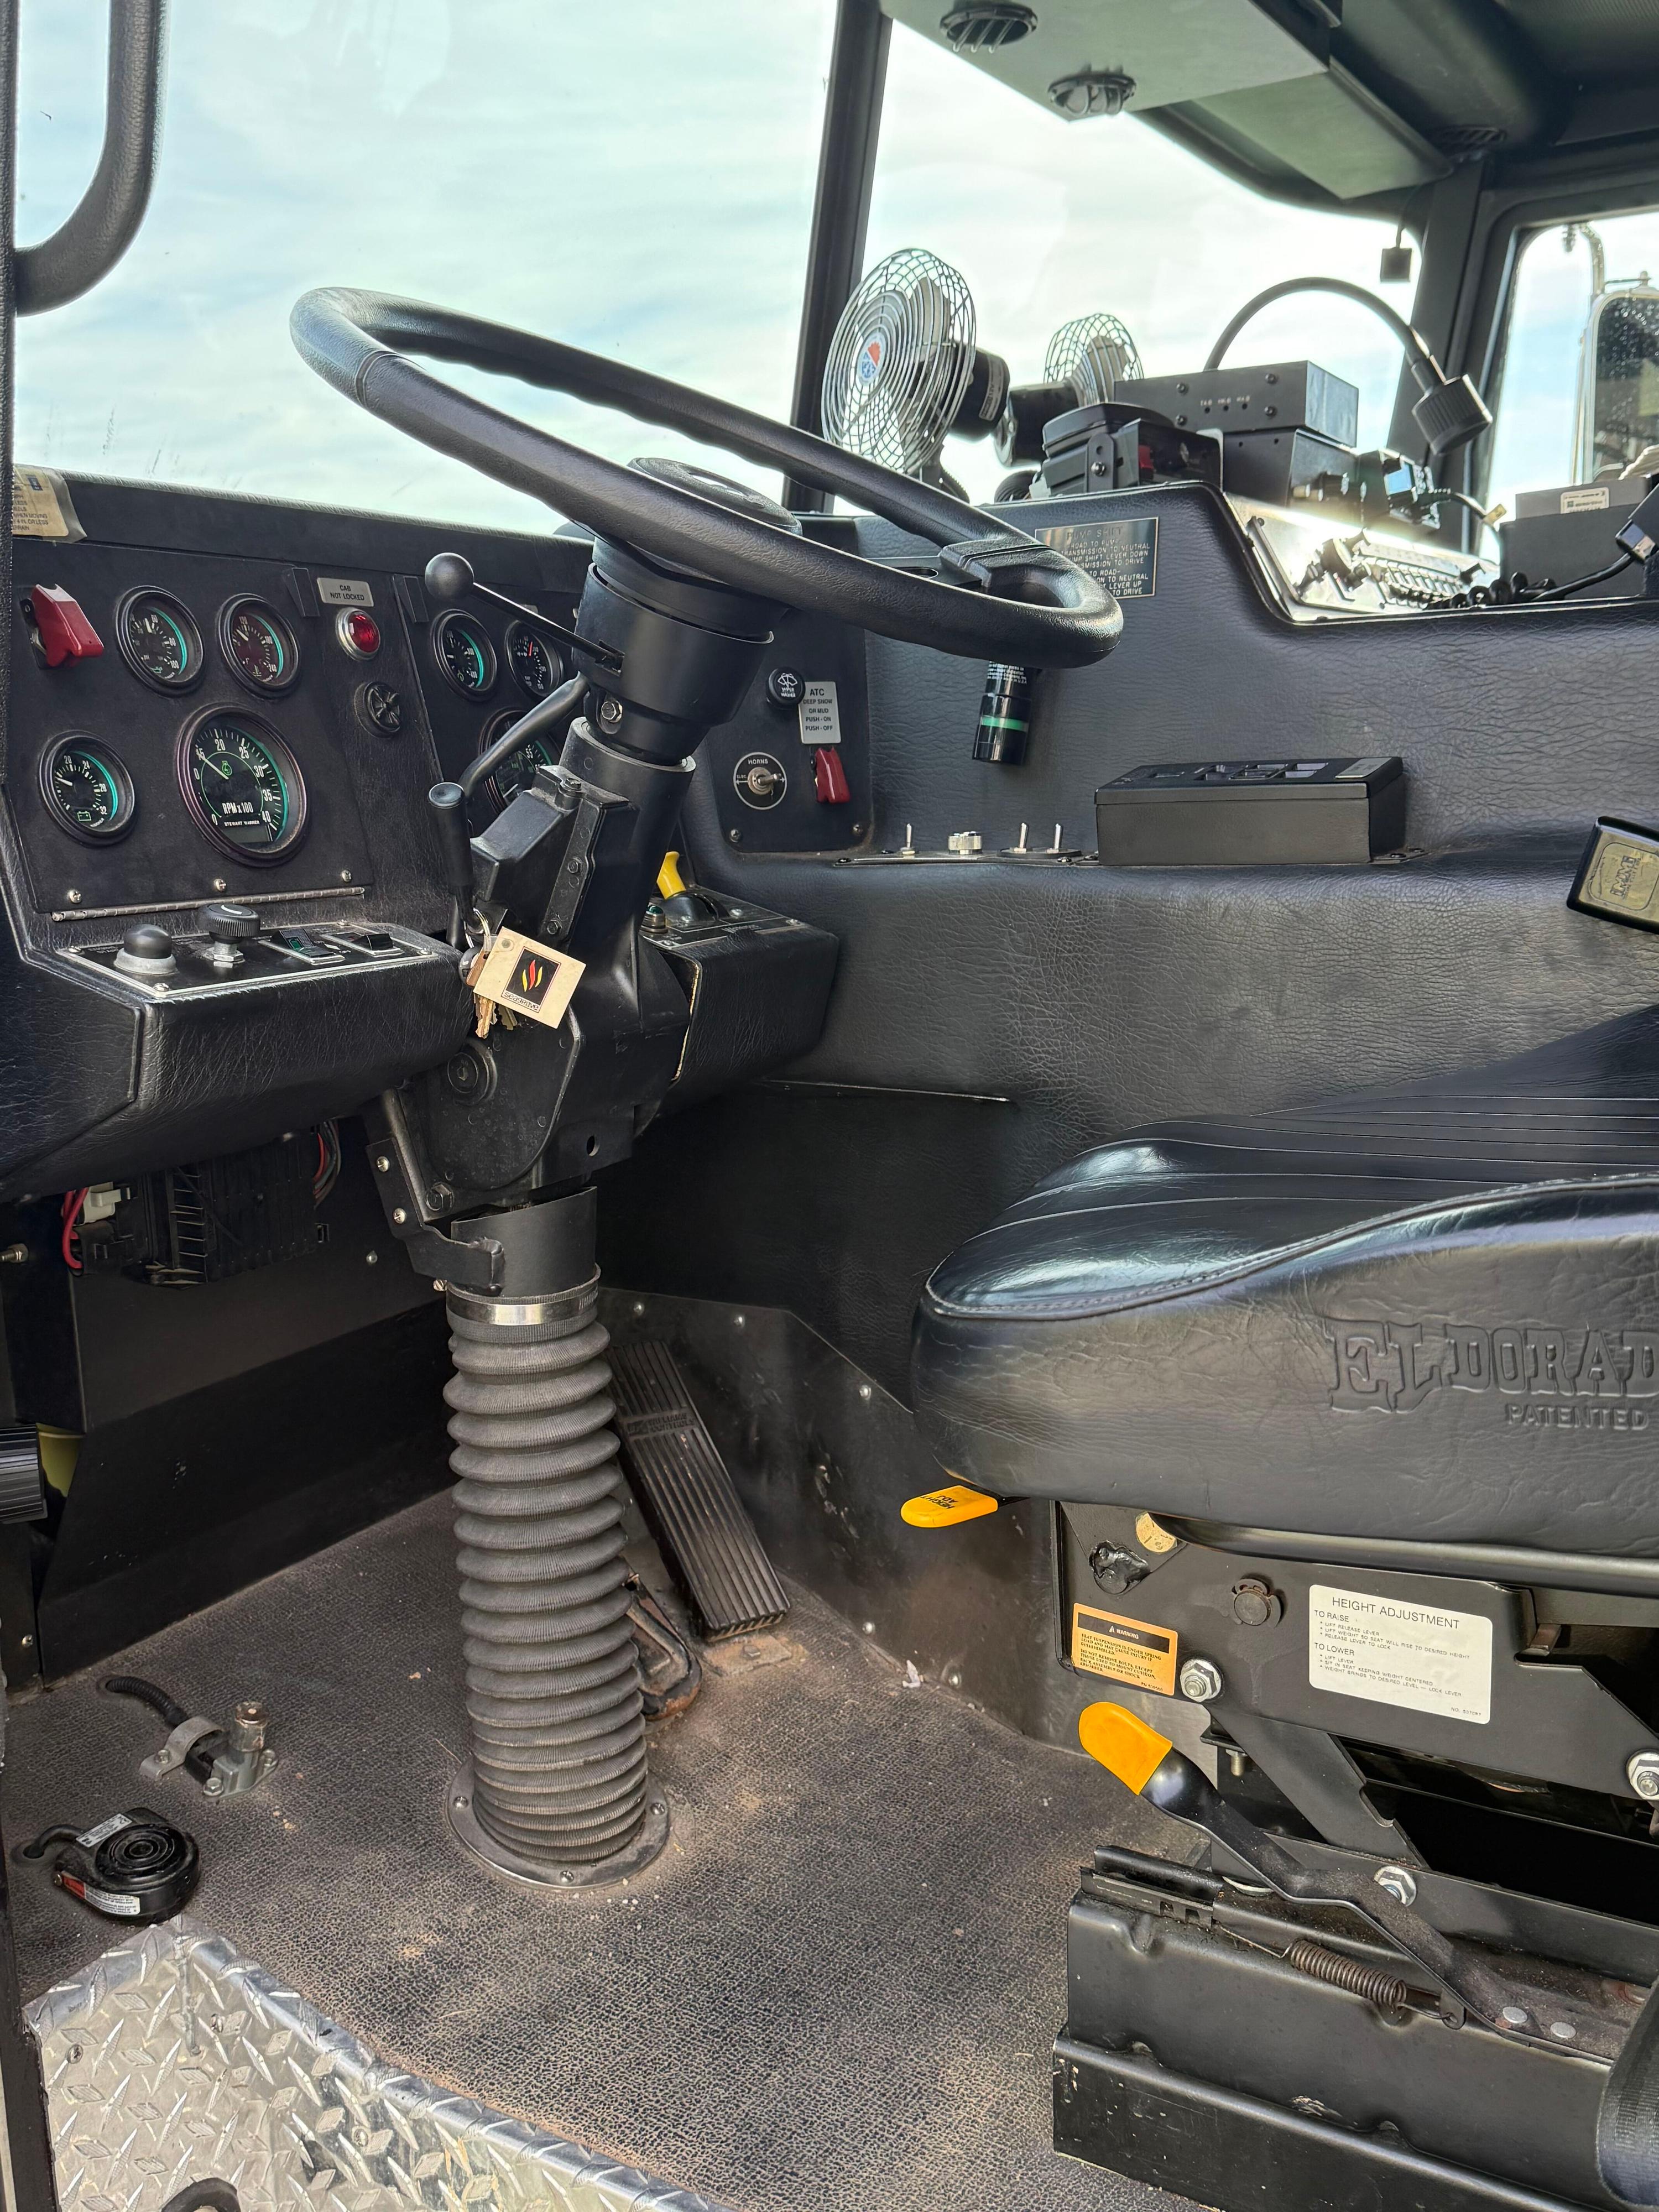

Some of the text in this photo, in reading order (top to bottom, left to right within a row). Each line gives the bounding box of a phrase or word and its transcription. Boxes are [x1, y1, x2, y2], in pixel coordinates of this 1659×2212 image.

[1121, 542, 1151, 551] NEUTRAL
[1085, 554, 1103, 562] SHIFT
[1107, 552, 1127, 560] LEVER
[1125, 557, 1144, 565] DRIVE
[1119, 573, 1149, 582] NEUTRAL
[1109, 582, 1130, 590] LEVER
[1123, 587, 1143, 596] DRIVE
[239, 616, 248, 624] 120
[810, 688, 825, 696] ATC
[215, 739, 226, 752] 20
[239, 747, 249, 759] 25
[525, 748, 534, 759] 55
[64, 755, 72, 764] 20
[82, 760, 91, 769] 24
[194, 768, 200, 780] 0
[253, 765, 265, 778] 30
[99, 783, 107, 792] 28
[262, 789, 273, 802] 35
[99, 805, 108, 815] 32
[262, 811, 272, 823] 40
[504, 991, 539, 1011] seagrave
[1504, 1404, 1650, 1431] PATENTED
[921, 1496, 956, 1509] HEIGHT
[1327, 1612, 1349, 1623] RAISE
[1332, 1597, 1460, 1629] HEIGHT ADJUSTMENT
[1116, 1628, 1139, 1640] WARNING
[1338, 1624, 1360, 1634] RELEASE
[1325, 1633, 1348, 1642] RELEASE
[1327, 1645, 1355, 1656] LOWER
[1144, 1652, 1161, 1660] SPRING
[1358, 1667, 1380, 1676] KEEPING
[1382, 1672, 1404, 1680] WEIGHT
[1405, 1676, 1433, 1687] CENTERED
[1378, 1677, 1401, 1686] DESIRED
